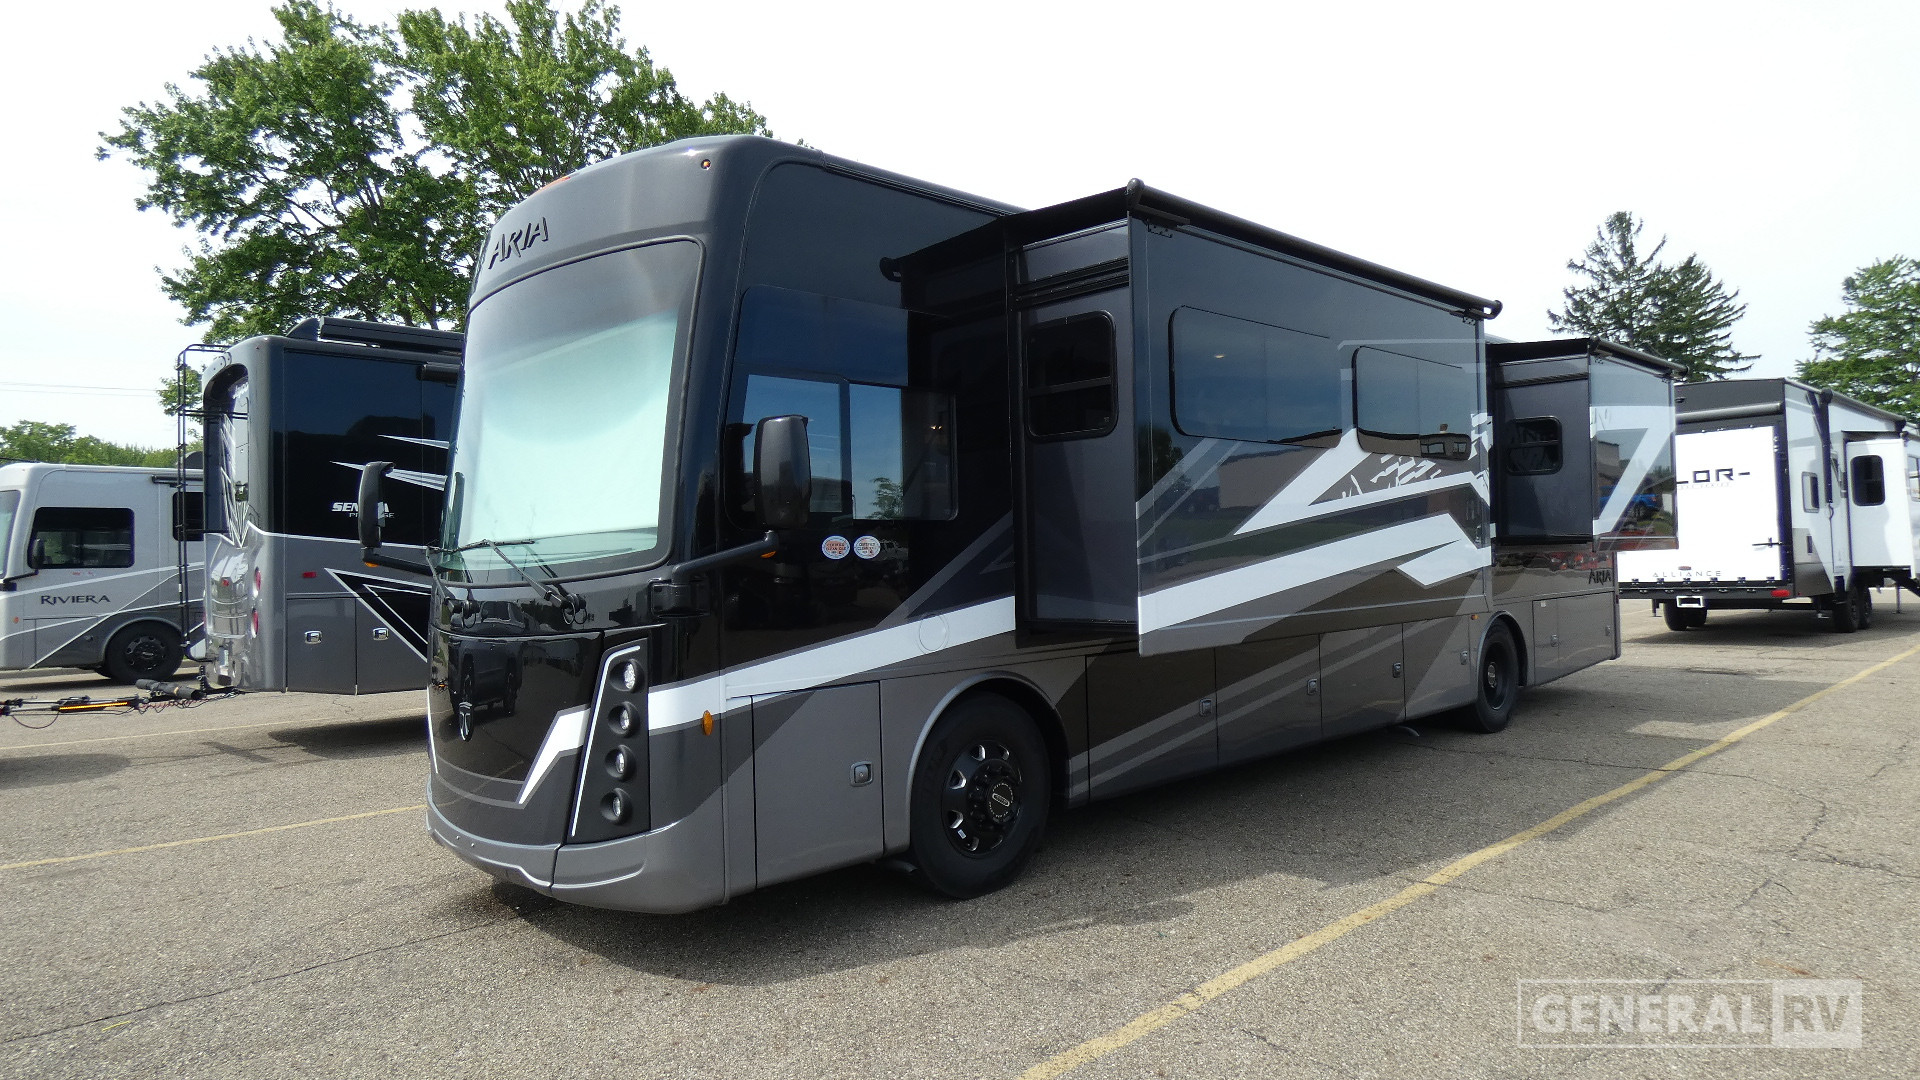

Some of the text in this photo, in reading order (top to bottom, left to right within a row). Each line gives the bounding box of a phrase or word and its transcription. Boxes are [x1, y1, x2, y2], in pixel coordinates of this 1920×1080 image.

[488, 216, 549, 269] ARIA
[1588, 568, 1611, 585] ARIA
[1652, 570, 1722, 578] ALLIANCE
[41, 595, 111, 605] RIVIERA
